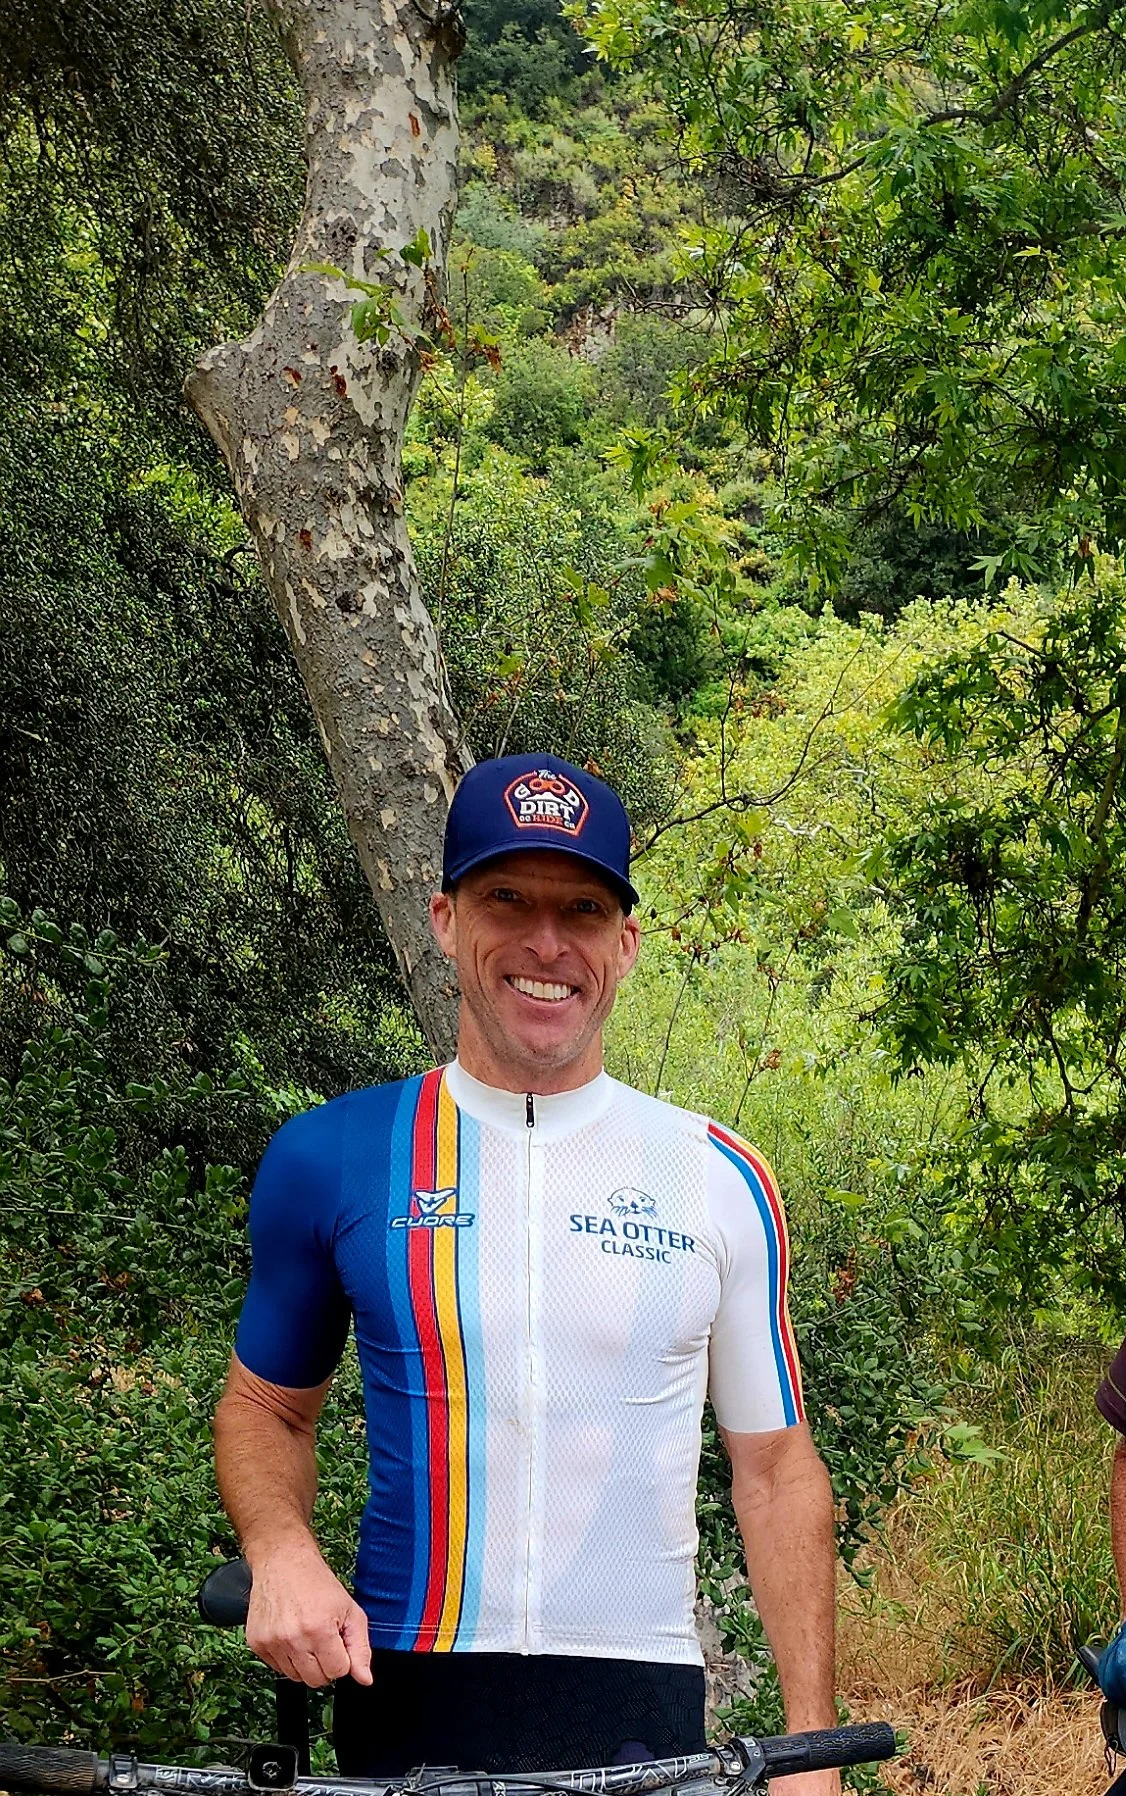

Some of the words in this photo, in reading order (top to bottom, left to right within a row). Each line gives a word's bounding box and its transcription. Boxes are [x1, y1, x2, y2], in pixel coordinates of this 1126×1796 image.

[538, 769, 557, 780] The
[520, 800, 575, 821] DIRT
[390, 1212, 475, 1229] CUORE
[569, 1214, 617, 1237] SEA
[622, 1221, 696, 1254] OTTER
[601, 1240, 672, 1264] CLASSIC
